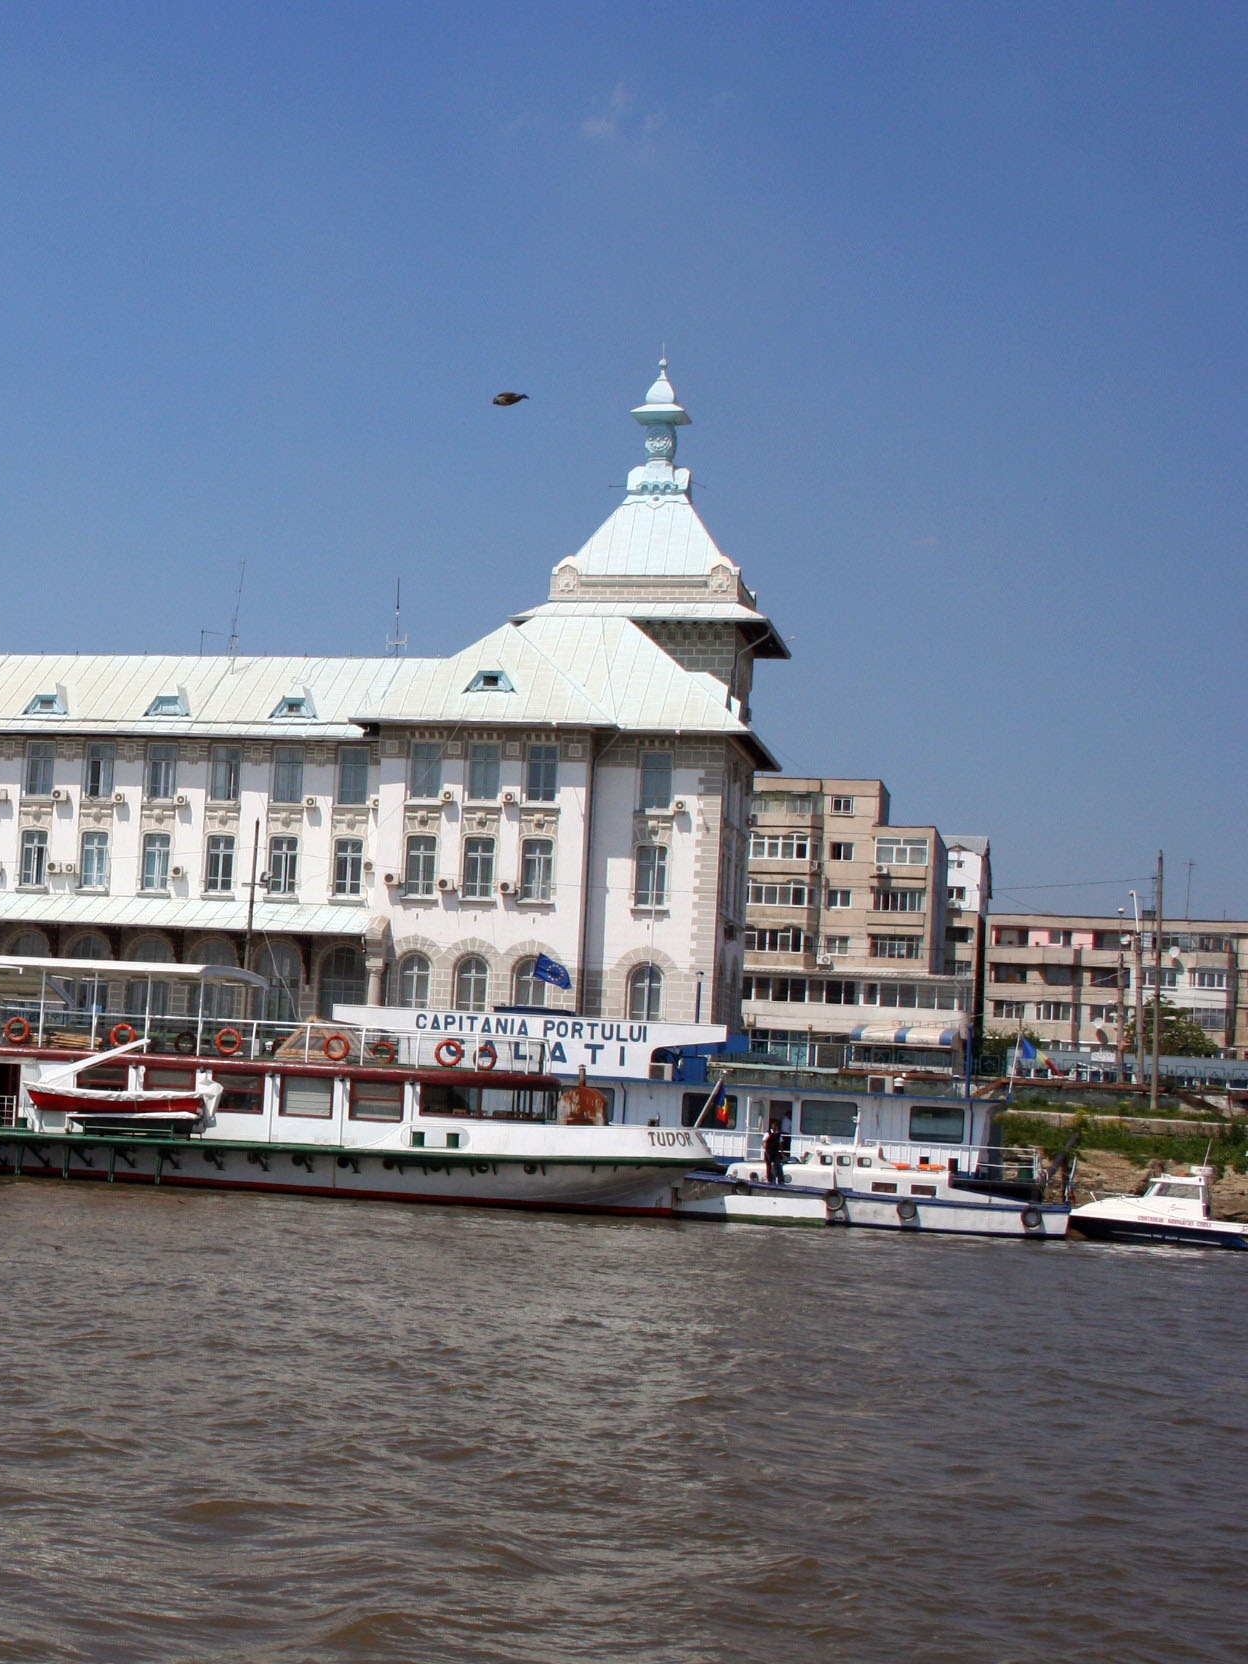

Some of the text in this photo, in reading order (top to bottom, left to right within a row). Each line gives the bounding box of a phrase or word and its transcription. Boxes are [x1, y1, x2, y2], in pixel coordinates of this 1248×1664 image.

[415, 1013, 648, 1043] CAPITANIA PORTULUI
[648, 1131, 694, 1147] TUDOR
